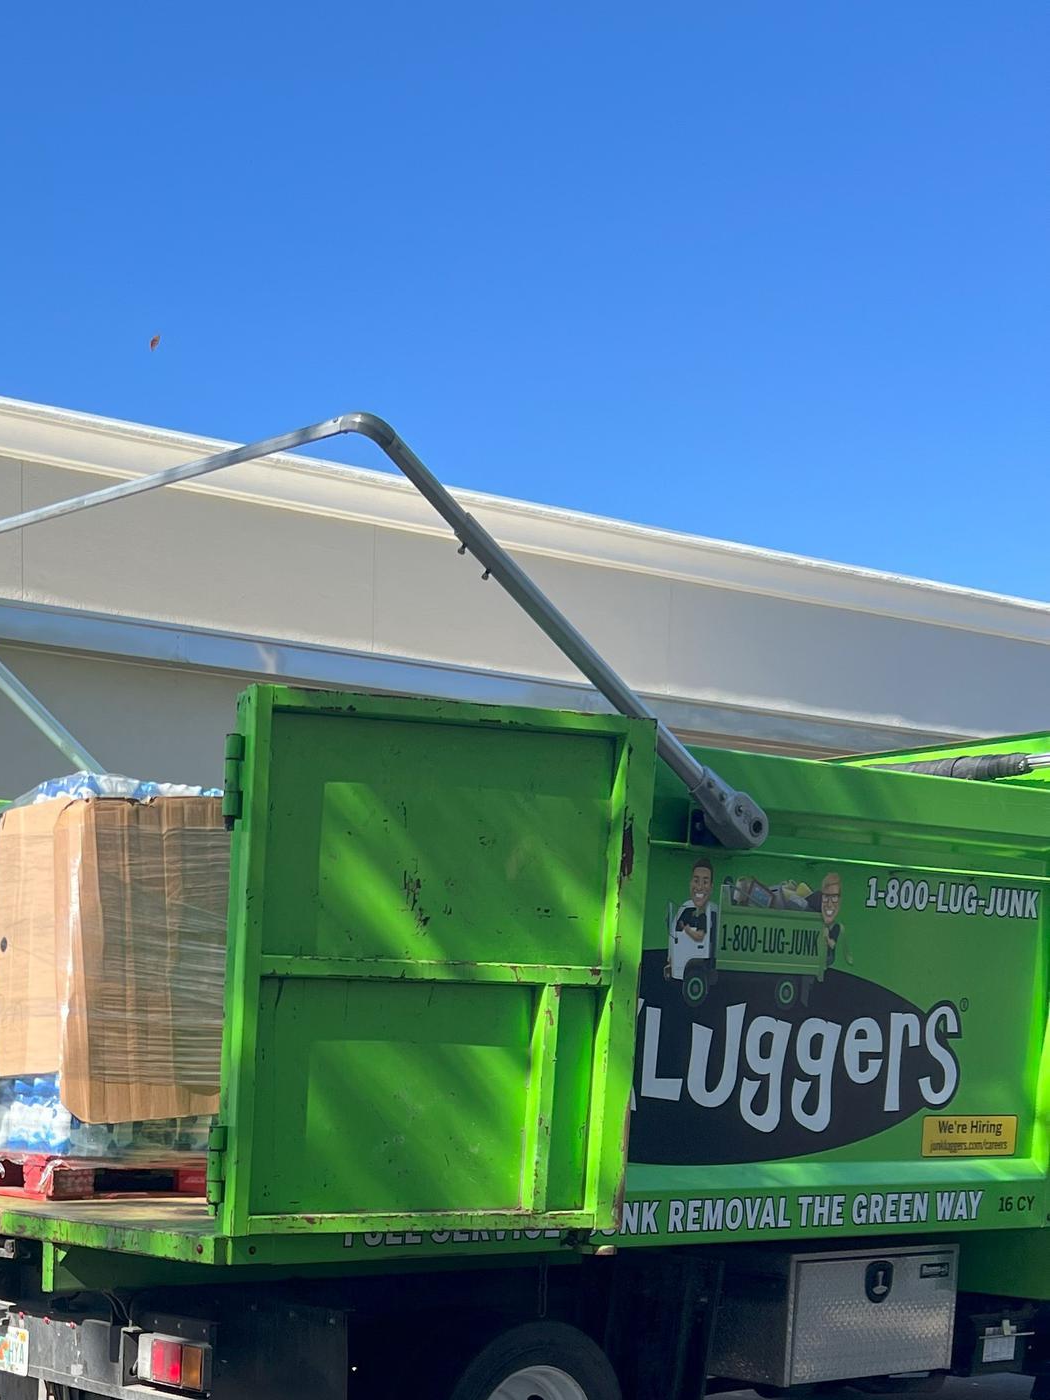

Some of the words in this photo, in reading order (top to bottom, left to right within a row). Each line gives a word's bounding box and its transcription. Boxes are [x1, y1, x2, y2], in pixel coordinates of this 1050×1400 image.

[866, 876, 1040, 919] 1-800-LUG-JUNK
[720, 923, 820, 957] 1-800-LUG-JUNK
[938, 1120, 968, 1134] We're
[970, 1120, 1003, 1137] Hiring
[667, 1197, 792, 1233] REMOVAL
[798, 1194, 846, 1228] THE
[852, 1191, 930, 1226] GREEN
[935, 1189, 984, 1222] WAY
[997, 1196, 1014, 1213] 16
[1016, 1195, 1036, 1212] CY
